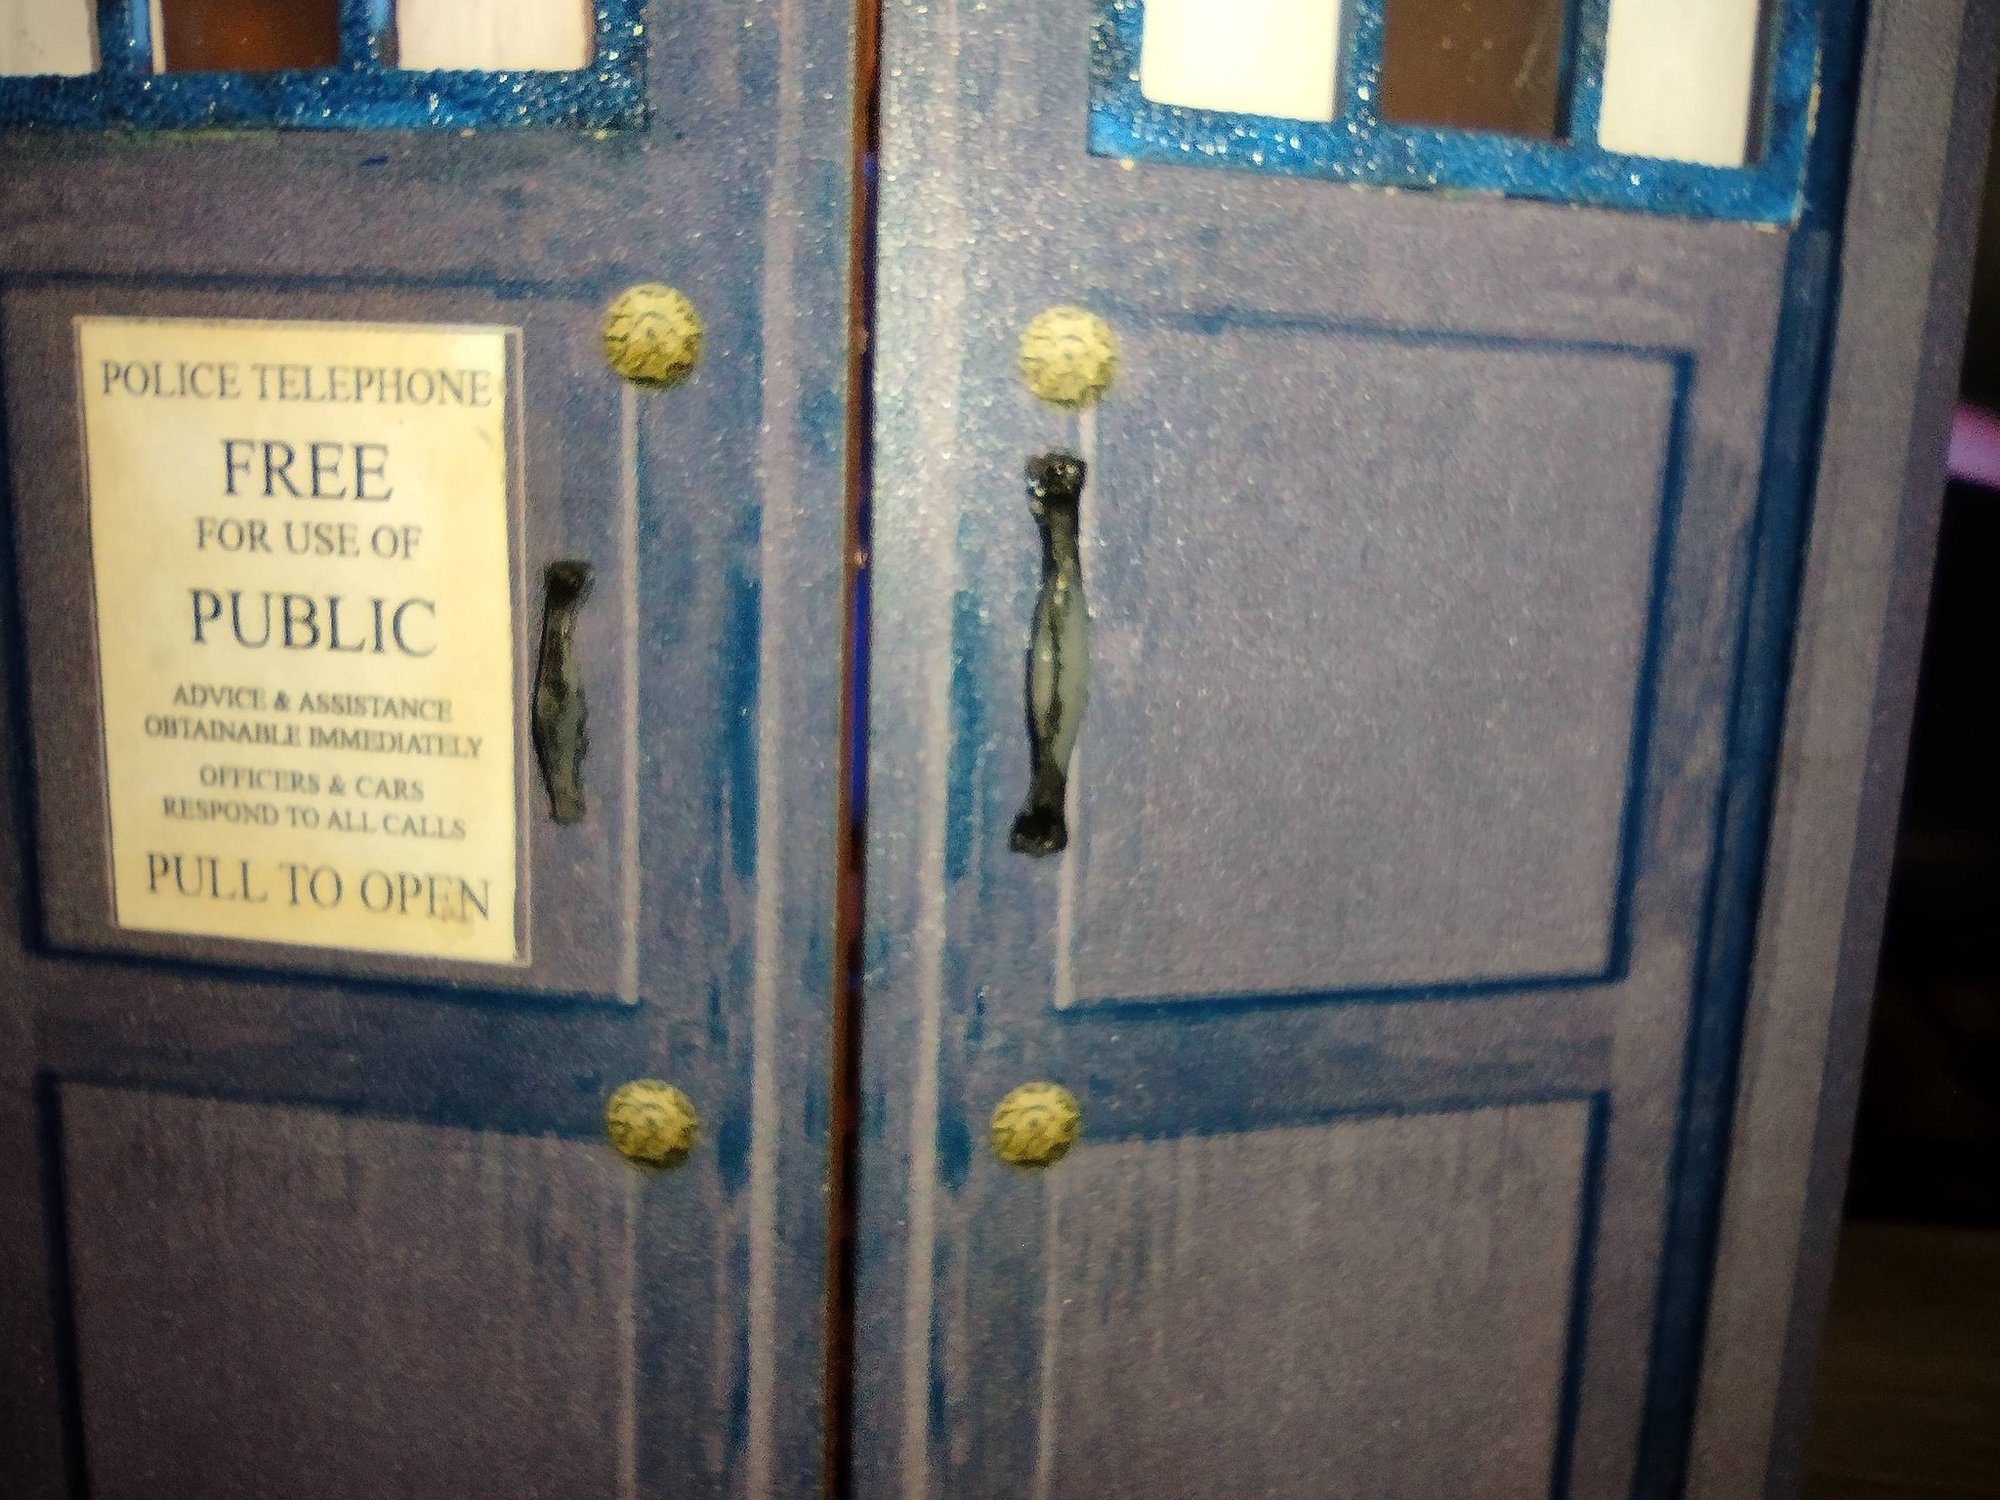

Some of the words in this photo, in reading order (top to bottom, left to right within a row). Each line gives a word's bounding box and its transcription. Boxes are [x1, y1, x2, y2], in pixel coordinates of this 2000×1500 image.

[100, 359, 241, 398] POLICE
[251, 363, 492, 407] TELEPHONE
[221, 439, 393, 501] FREE
[195, 517, 272, 553] FOR
[285, 521, 360, 558] USE
[371, 525, 423, 560] OF
[189, 588, 436, 657] PUBLIC
[173, 684, 266, 711] ADVICE
[274, 691, 289, 712] &
[299, 693, 452, 722] ASSISTANCE
[145, 714, 300, 747] OBTAINABLE
[309, 725, 483, 758] IMMEDIATELY
[201, 765, 320, 793] OFFICERS
[329, 775, 345, 795] &
[356, 776, 424, 801] CARS
[163, 796, 279, 825] RESPOND
[286, 806, 319, 828] TO
[328, 812, 376, 834] ALL
[383, 814, 466, 839] CALLS
[146, 853, 267, 902] PULL
[279, 862, 342, 908] TO
[360, 870, 491, 920] OPEN
